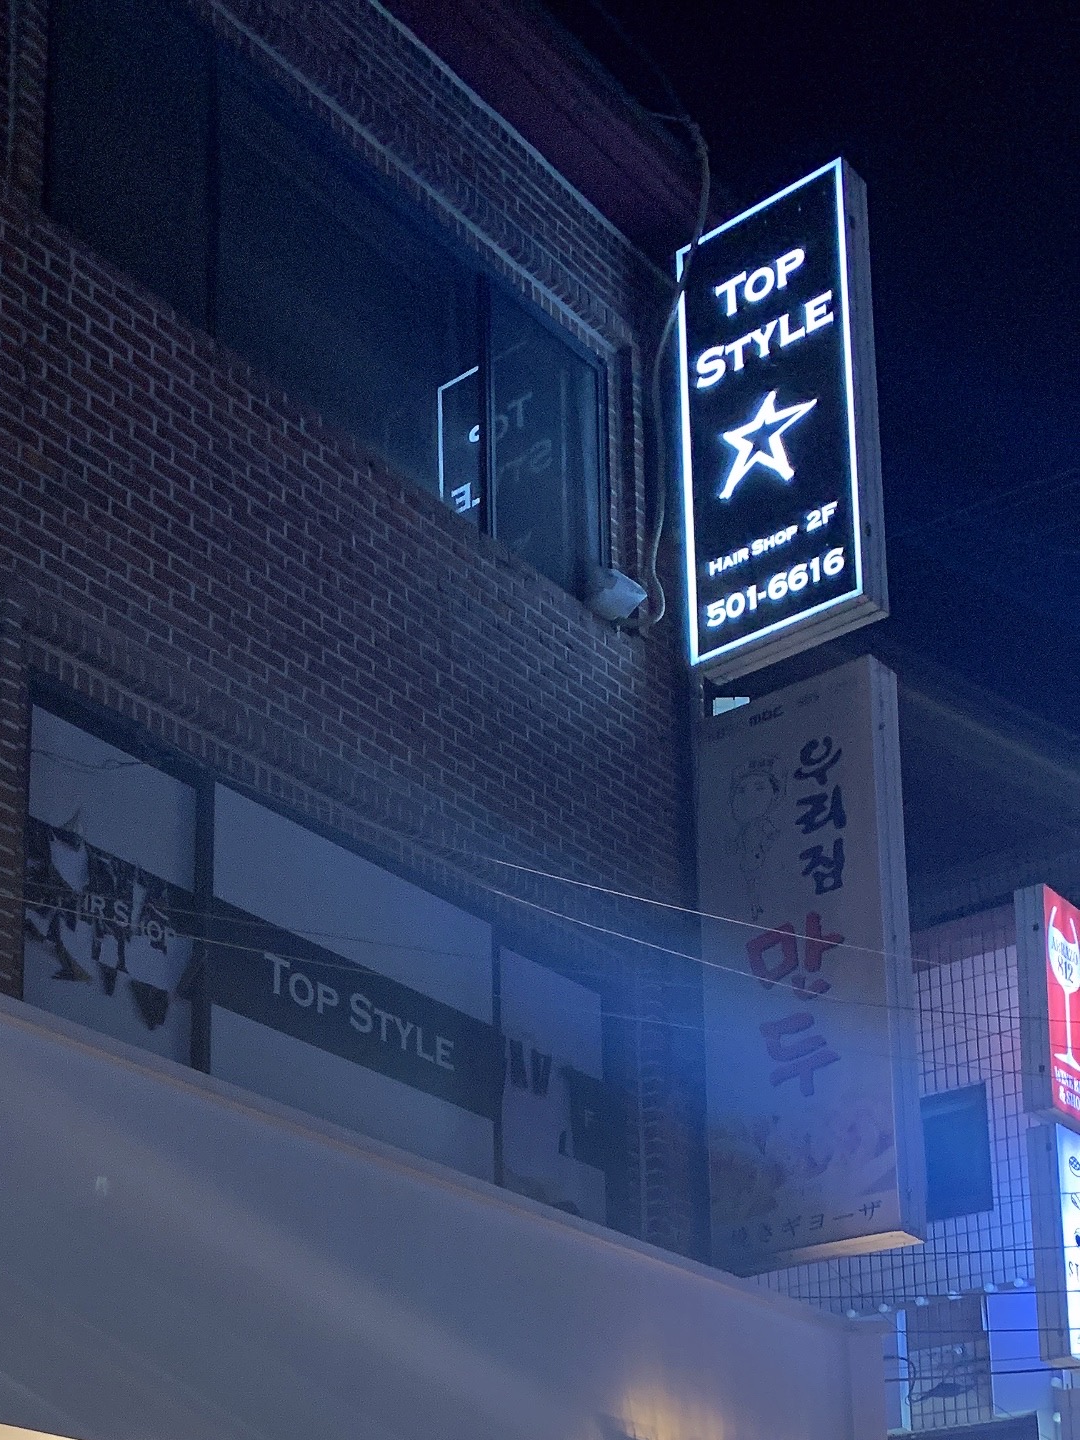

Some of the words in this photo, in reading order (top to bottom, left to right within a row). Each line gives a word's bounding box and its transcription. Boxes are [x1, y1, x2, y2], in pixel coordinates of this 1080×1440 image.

[715, 248, 806, 318] TOP
[696, 290, 834, 389] STYLE
[706, 547, 846, 628] 501-6616
[708, 547, 749, 577] HAIR
[751, 523, 798, 559] SHOP
[805, 500, 839, 532] 2F
[794, 735, 847, 895] 우리집
[264, 951, 340, 1014] TOP
[349, 993, 455, 1071] STYLE
[746, 911, 845, 1097] 만두
